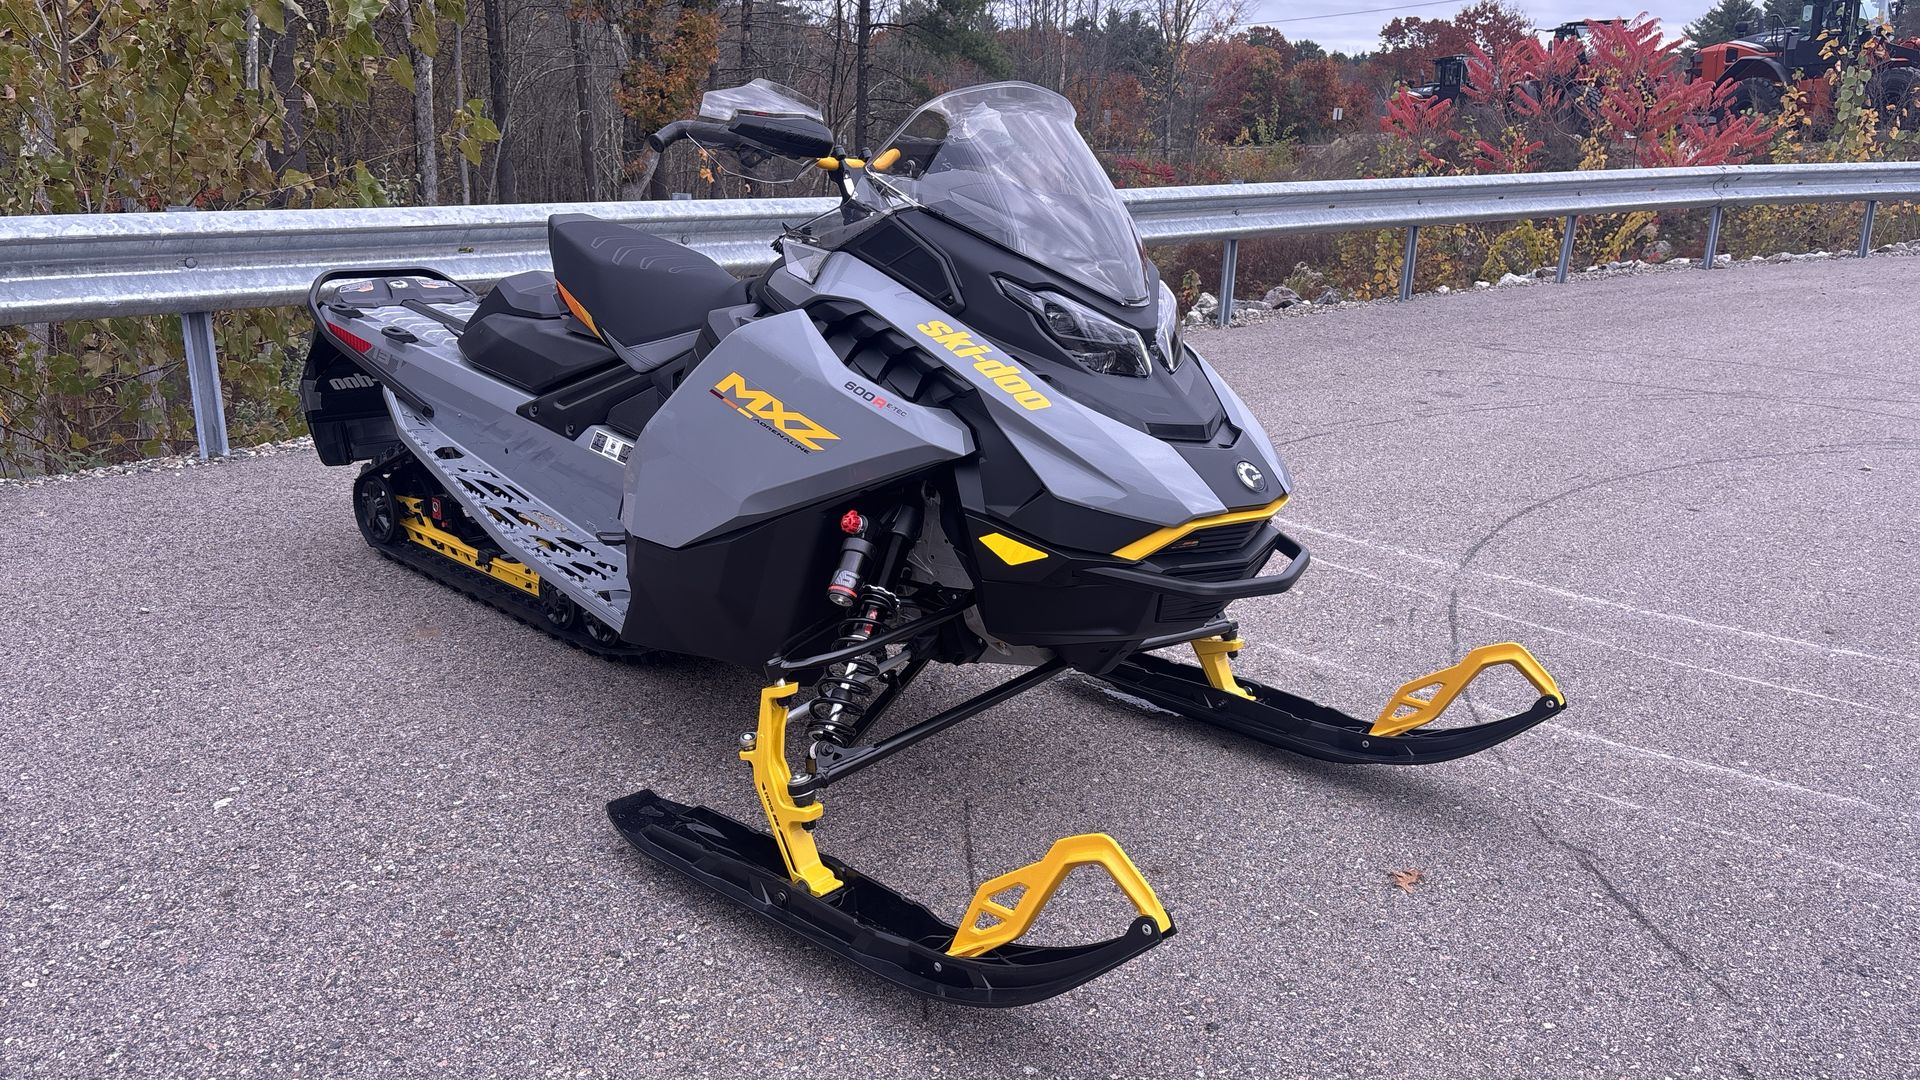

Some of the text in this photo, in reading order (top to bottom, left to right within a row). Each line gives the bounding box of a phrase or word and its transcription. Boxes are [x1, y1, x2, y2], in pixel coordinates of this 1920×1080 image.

[916, 320, 1052, 411] ski-doo
[714, 371, 841, 451] MXZ
[844, 381, 907, 417] 600R E-TEC
[753, 418, 811, 455] ADRENALINE
